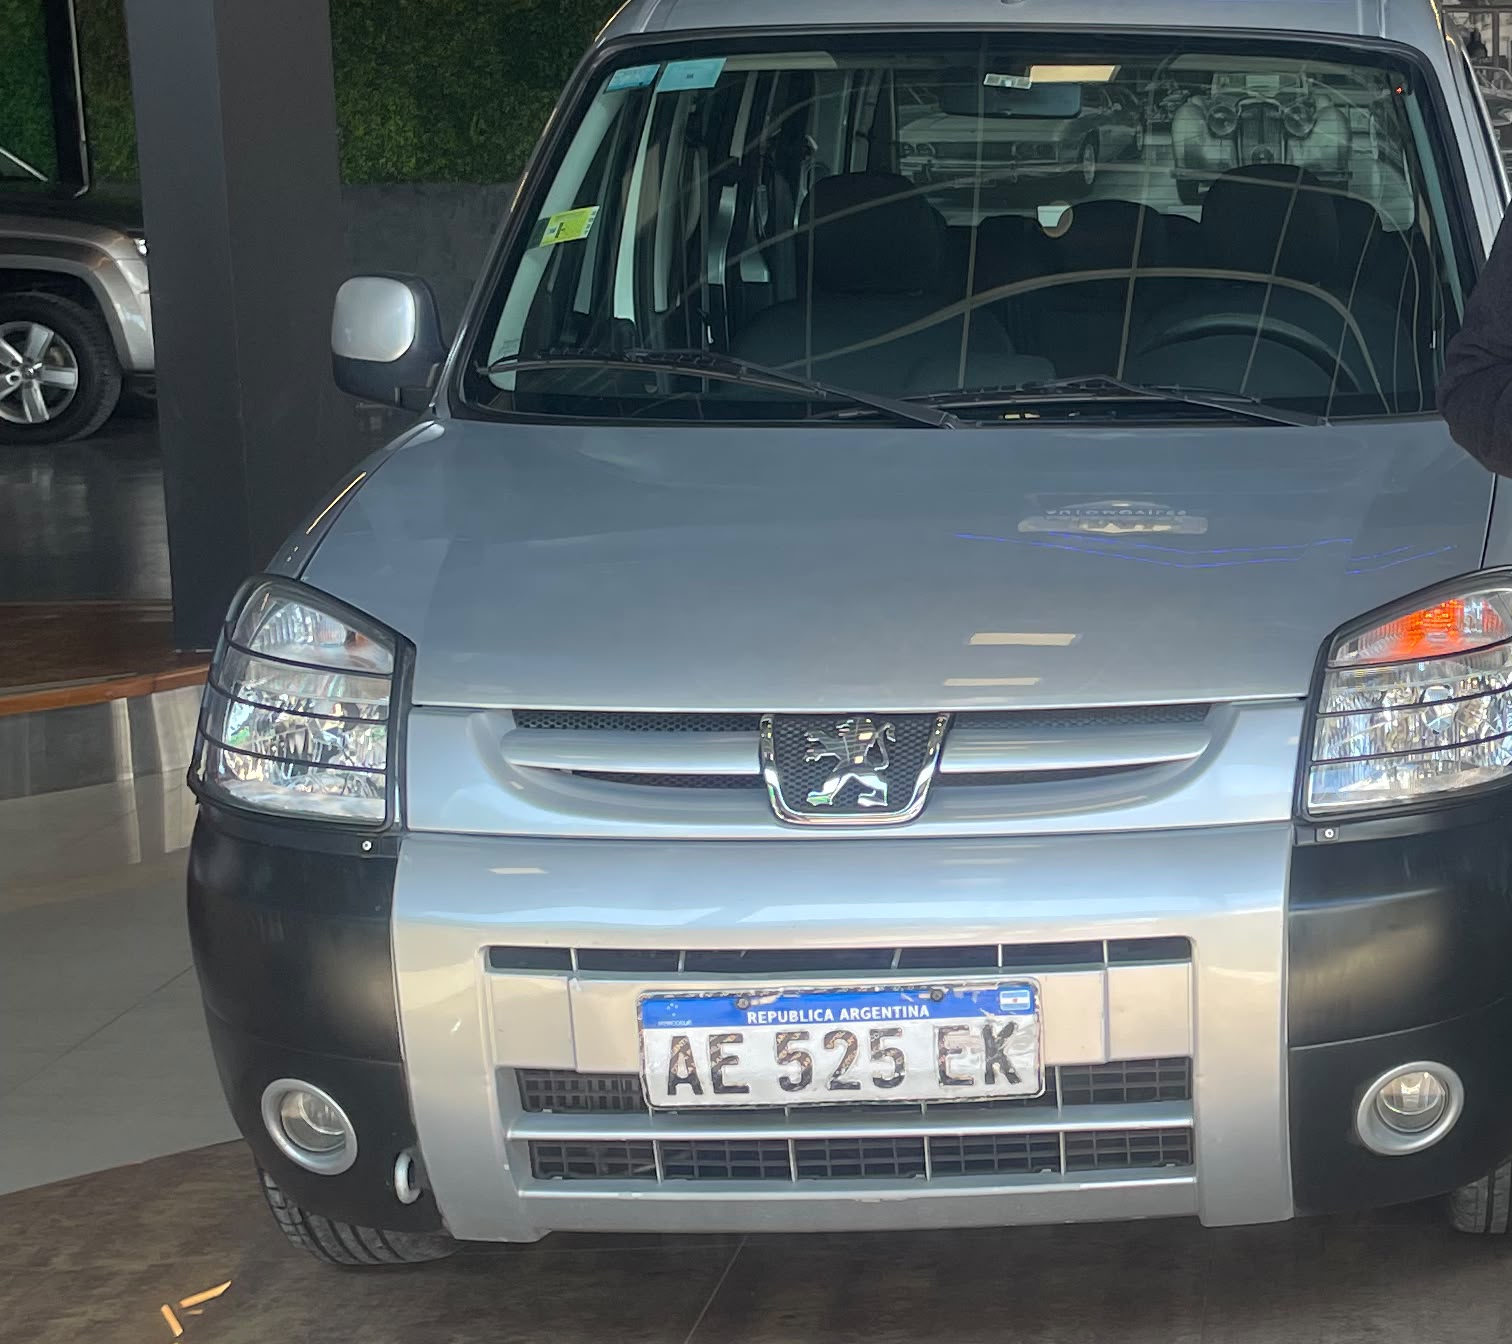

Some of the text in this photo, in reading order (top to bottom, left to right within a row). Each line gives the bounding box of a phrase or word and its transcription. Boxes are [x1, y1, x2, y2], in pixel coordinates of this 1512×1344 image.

[746, 1004, 931, 1025] REPUBLICA ARGENTINA
[666, 1020, 1023, 1096] AE 525 EK
